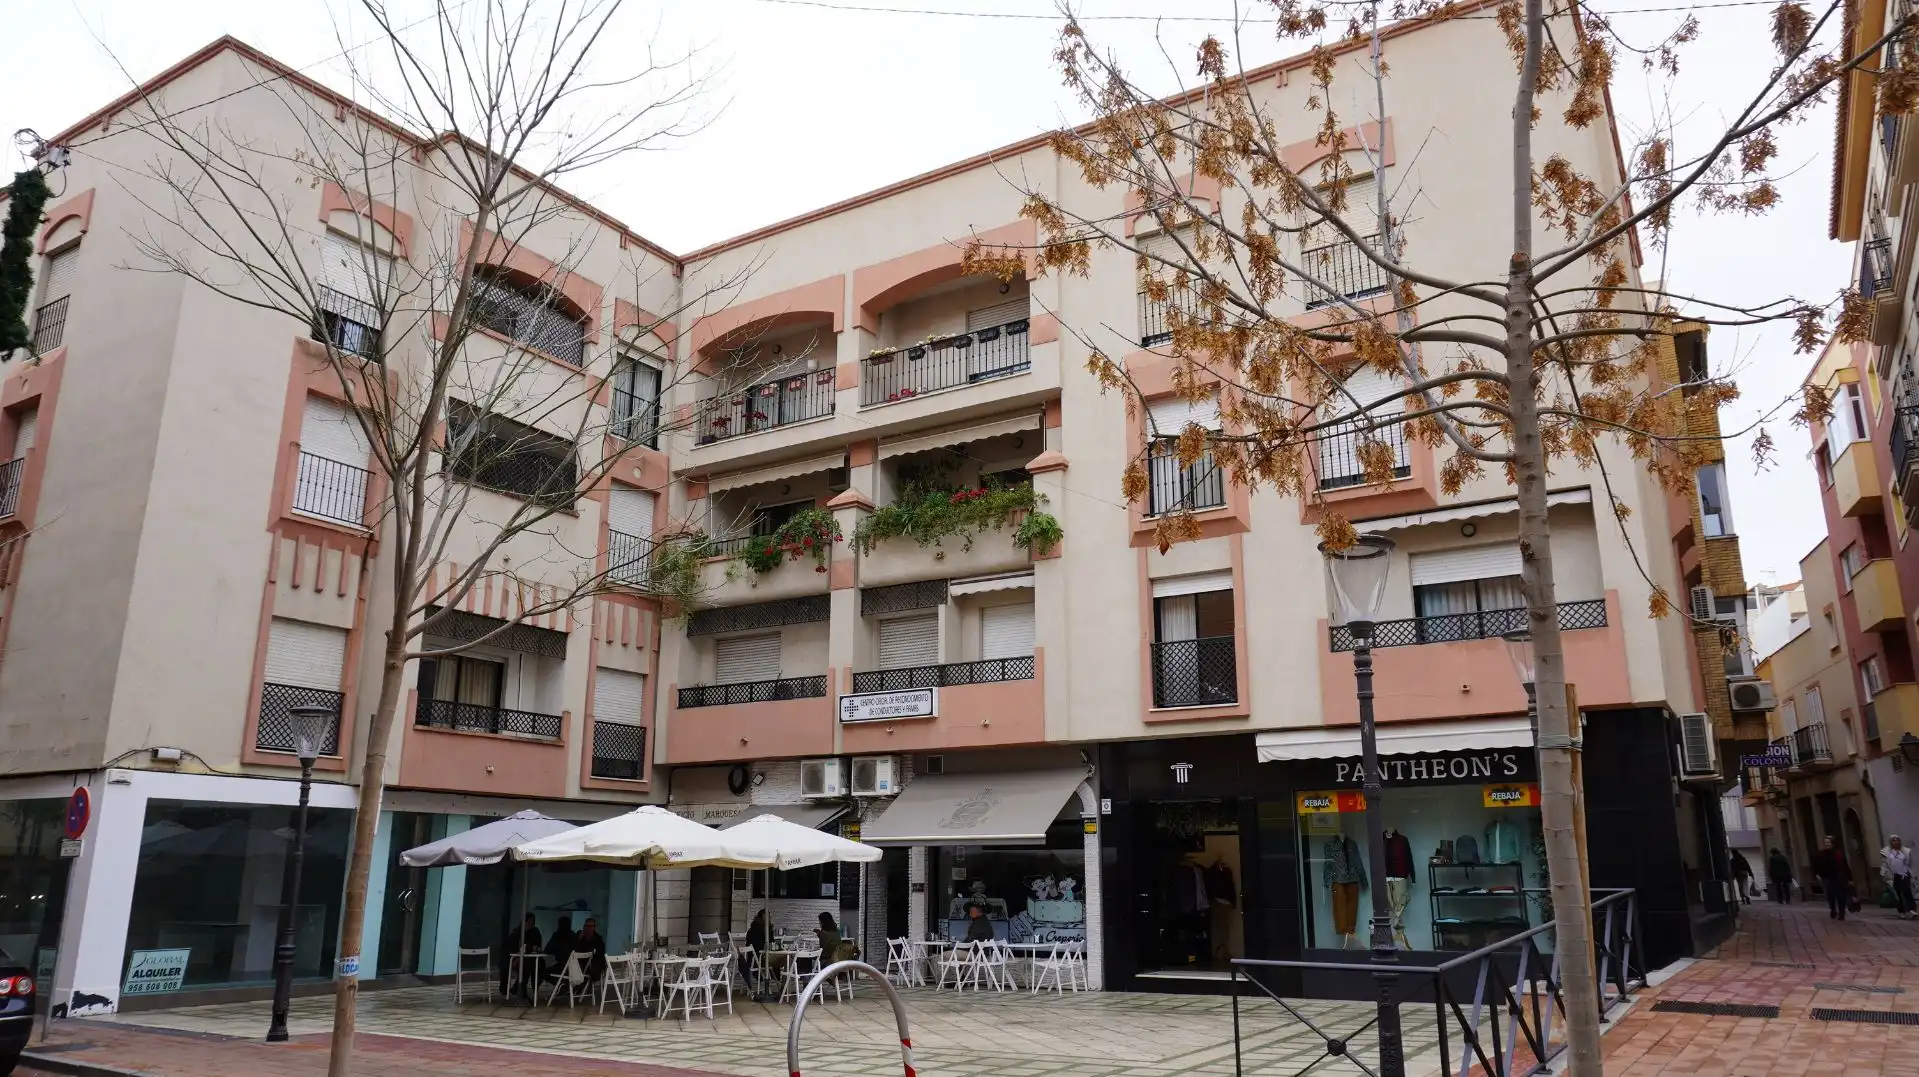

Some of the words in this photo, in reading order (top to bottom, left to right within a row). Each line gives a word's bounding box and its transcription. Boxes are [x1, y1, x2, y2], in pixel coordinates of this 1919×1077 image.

[1336, 752, 1519, 782] PANTHEON'S
[1491, 791, 1521, 801] REBAJA
[1304, 798, 1330, 807] REBAJA
[132, 967, 182, 978] ALQUILER
[128, 983, 143, 991] 958
